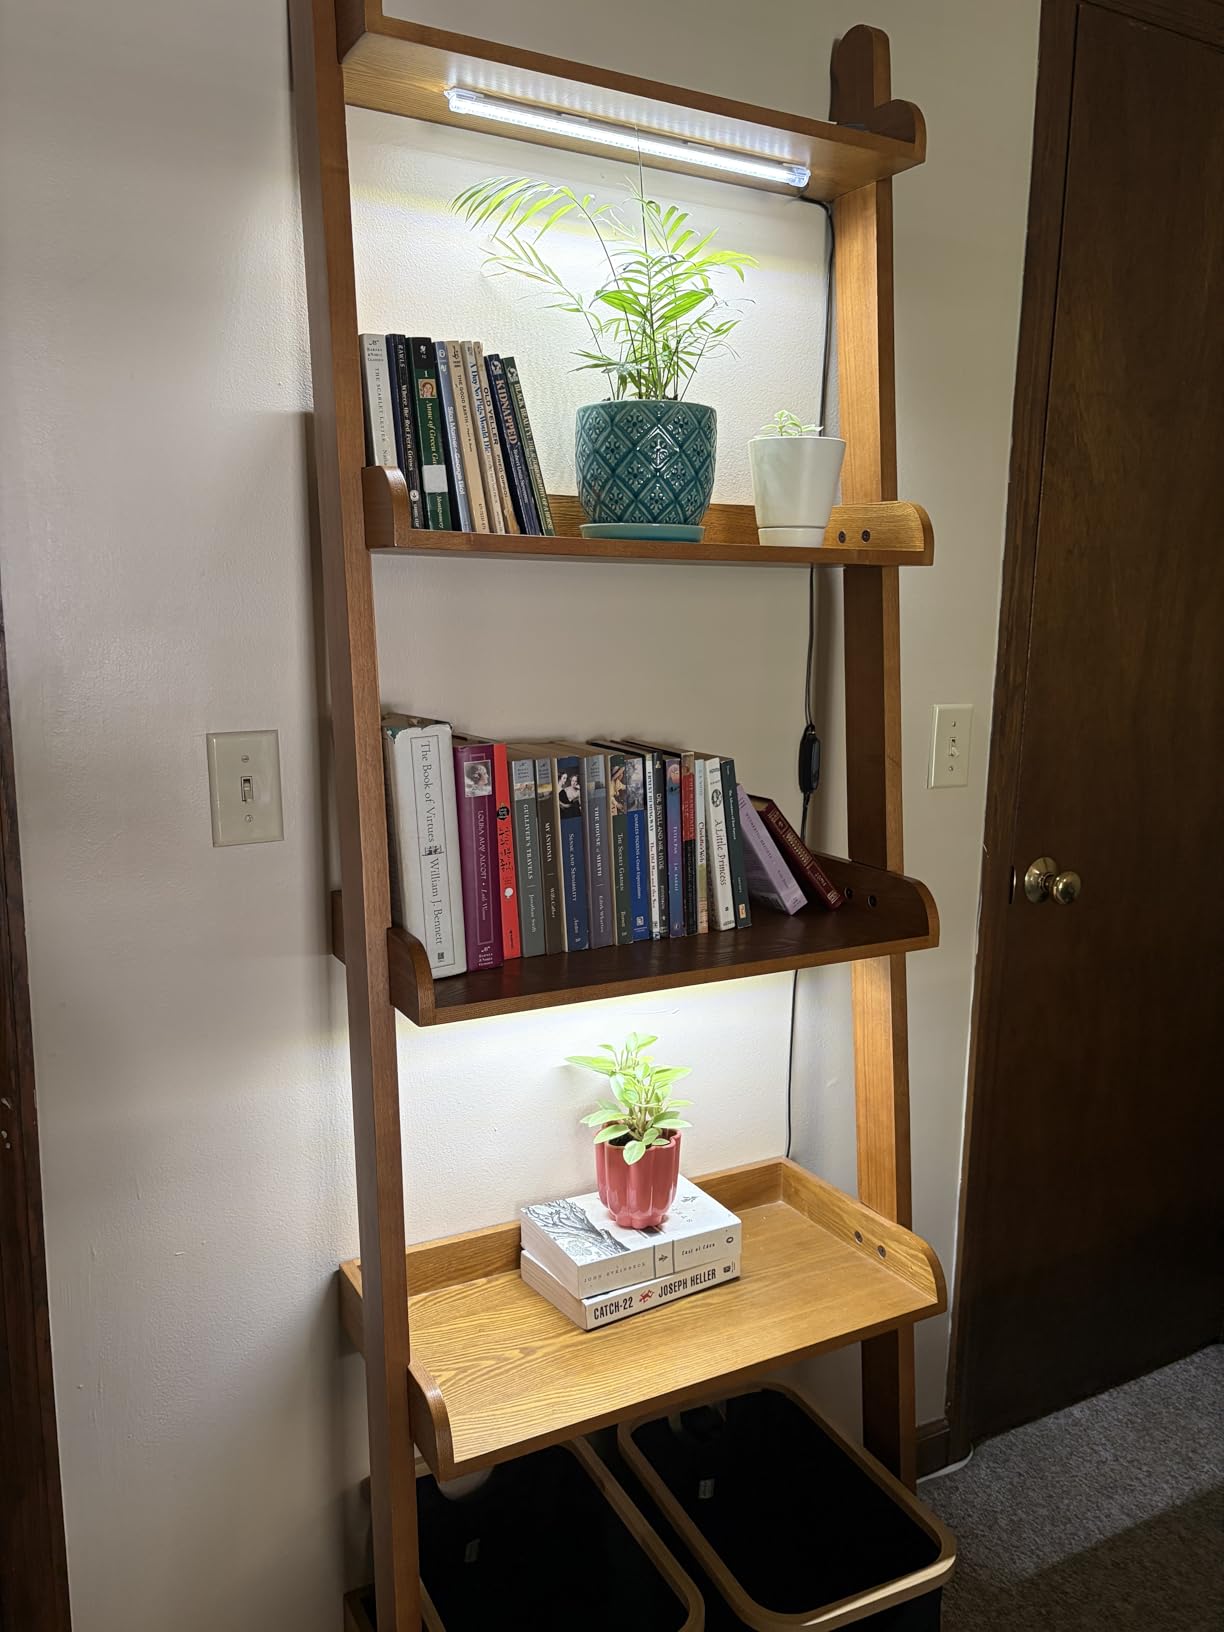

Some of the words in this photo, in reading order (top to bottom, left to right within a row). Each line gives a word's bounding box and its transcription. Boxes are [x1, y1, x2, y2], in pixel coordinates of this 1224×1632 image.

[470, 370, 478, 386] Day
[473, 386, 481, 397] No
[447, 406, 455, 422] Silas
[474, 398, 485, 416] Pigs
[483, 387, 491, 407] OLD
[487, 409, 500, 445] YELLER
[496, 380, 517, 443] KIDNAPPED
[379, 416, 387, 442] LETTER
[427, 420, 436, 429] of
[449, 422, 459, 448] Marner
[479, 415, 489, 439] Would
[483, 440, 491, 453] Die
[514, 383, 525, 407] BLACK
[545, 511, 553, 529] HORSE
[454, 452, 463, 480] George
[496, 454, 504, 472] FRED
[457, 480, 465, 495] Eliot
[436, 496, 444, 528] Montgomery
[420, 741, 431, 761] The
[422, 764, 433, 789] Book
[424, 792, 435, 803] of
[426, 807, 436, 842] Virtues
[523, 804, 531, 846] GULLIVER'S
[545, 822, 550, 831] MY
[714, 819, 723, 827] A
[478, 836, 486, 852] MAY
[715, 829, 725, 850] Little
[430, 858, 440, 897] William
[479, 854, 487, 879] ALCOTT
[717, 854, 726, 885] Princess
[433, 909, 444, 944] Bennett
[584, 1274, 602, 1283] JOHN
[606, 1262, 645, 1276] STEINBECK
[593, 1297, 633, 1319] CATCH-22
[658, 1279, 687, 1297] JOSEPH
[690, 1269, 716, 1286] HELLER
